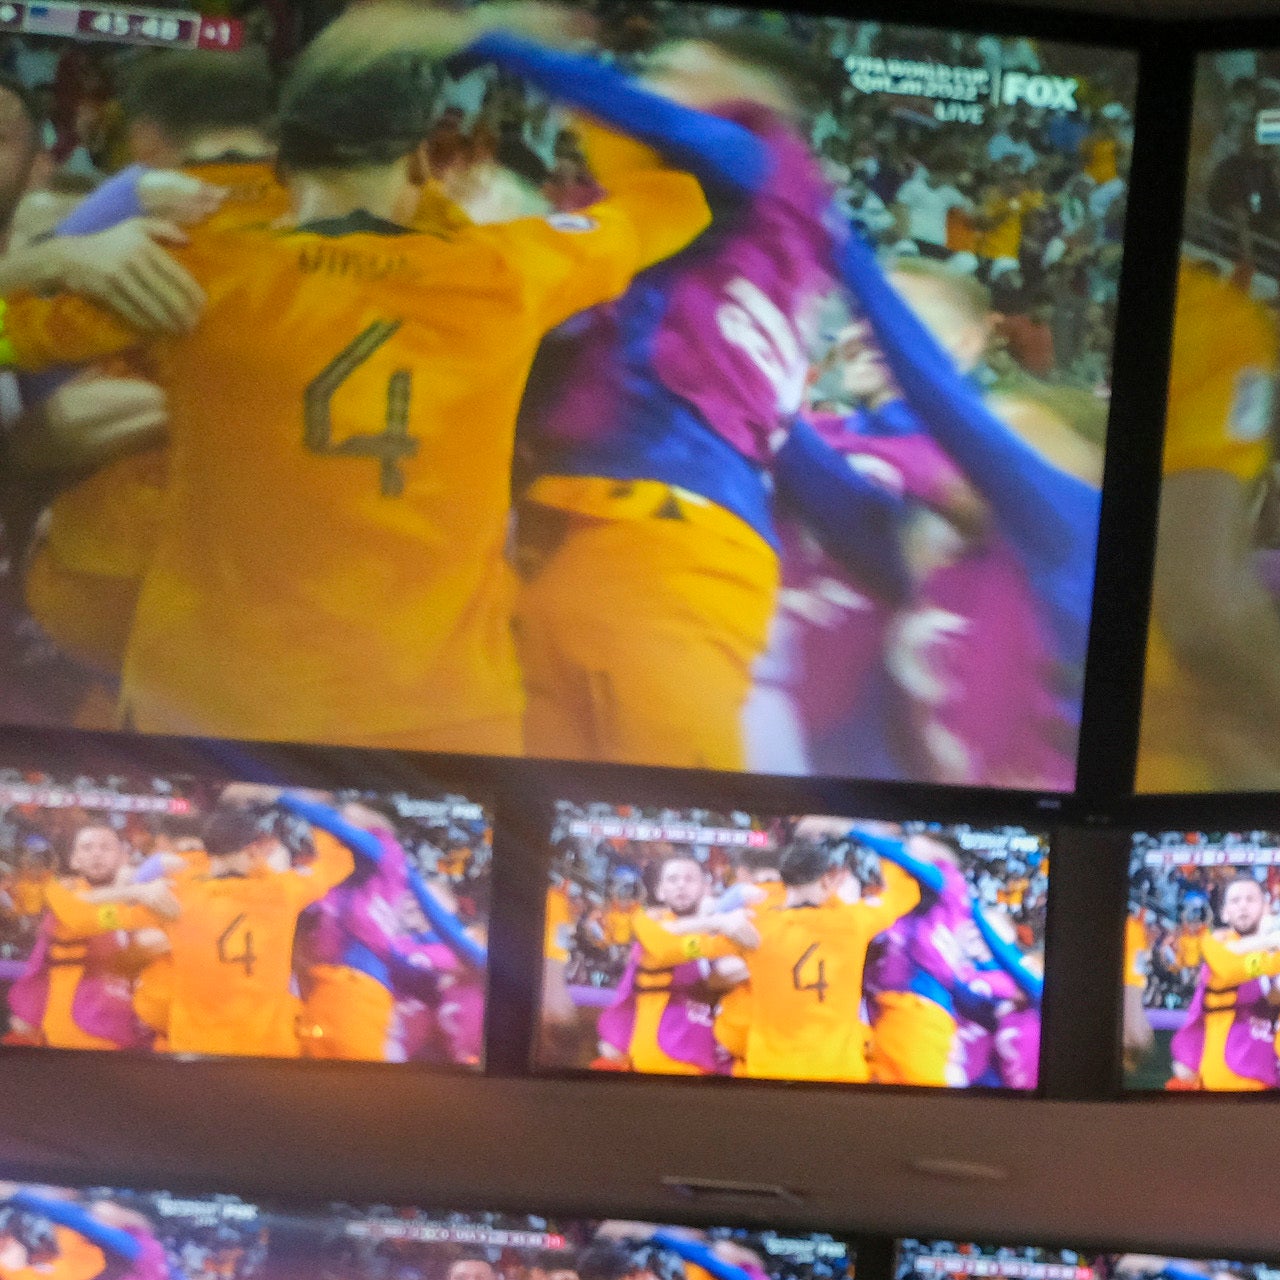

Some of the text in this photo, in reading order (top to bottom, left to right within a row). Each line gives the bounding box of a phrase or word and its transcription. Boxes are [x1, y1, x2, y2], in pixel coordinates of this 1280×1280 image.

[932, 100, 984, 126] LIVE
[1002, 70, 1079, 112] FOX
[303, 317, 420, 498] 4
[216, 911, 258, 977] 4
[791, 942, 829, 1003] 4
